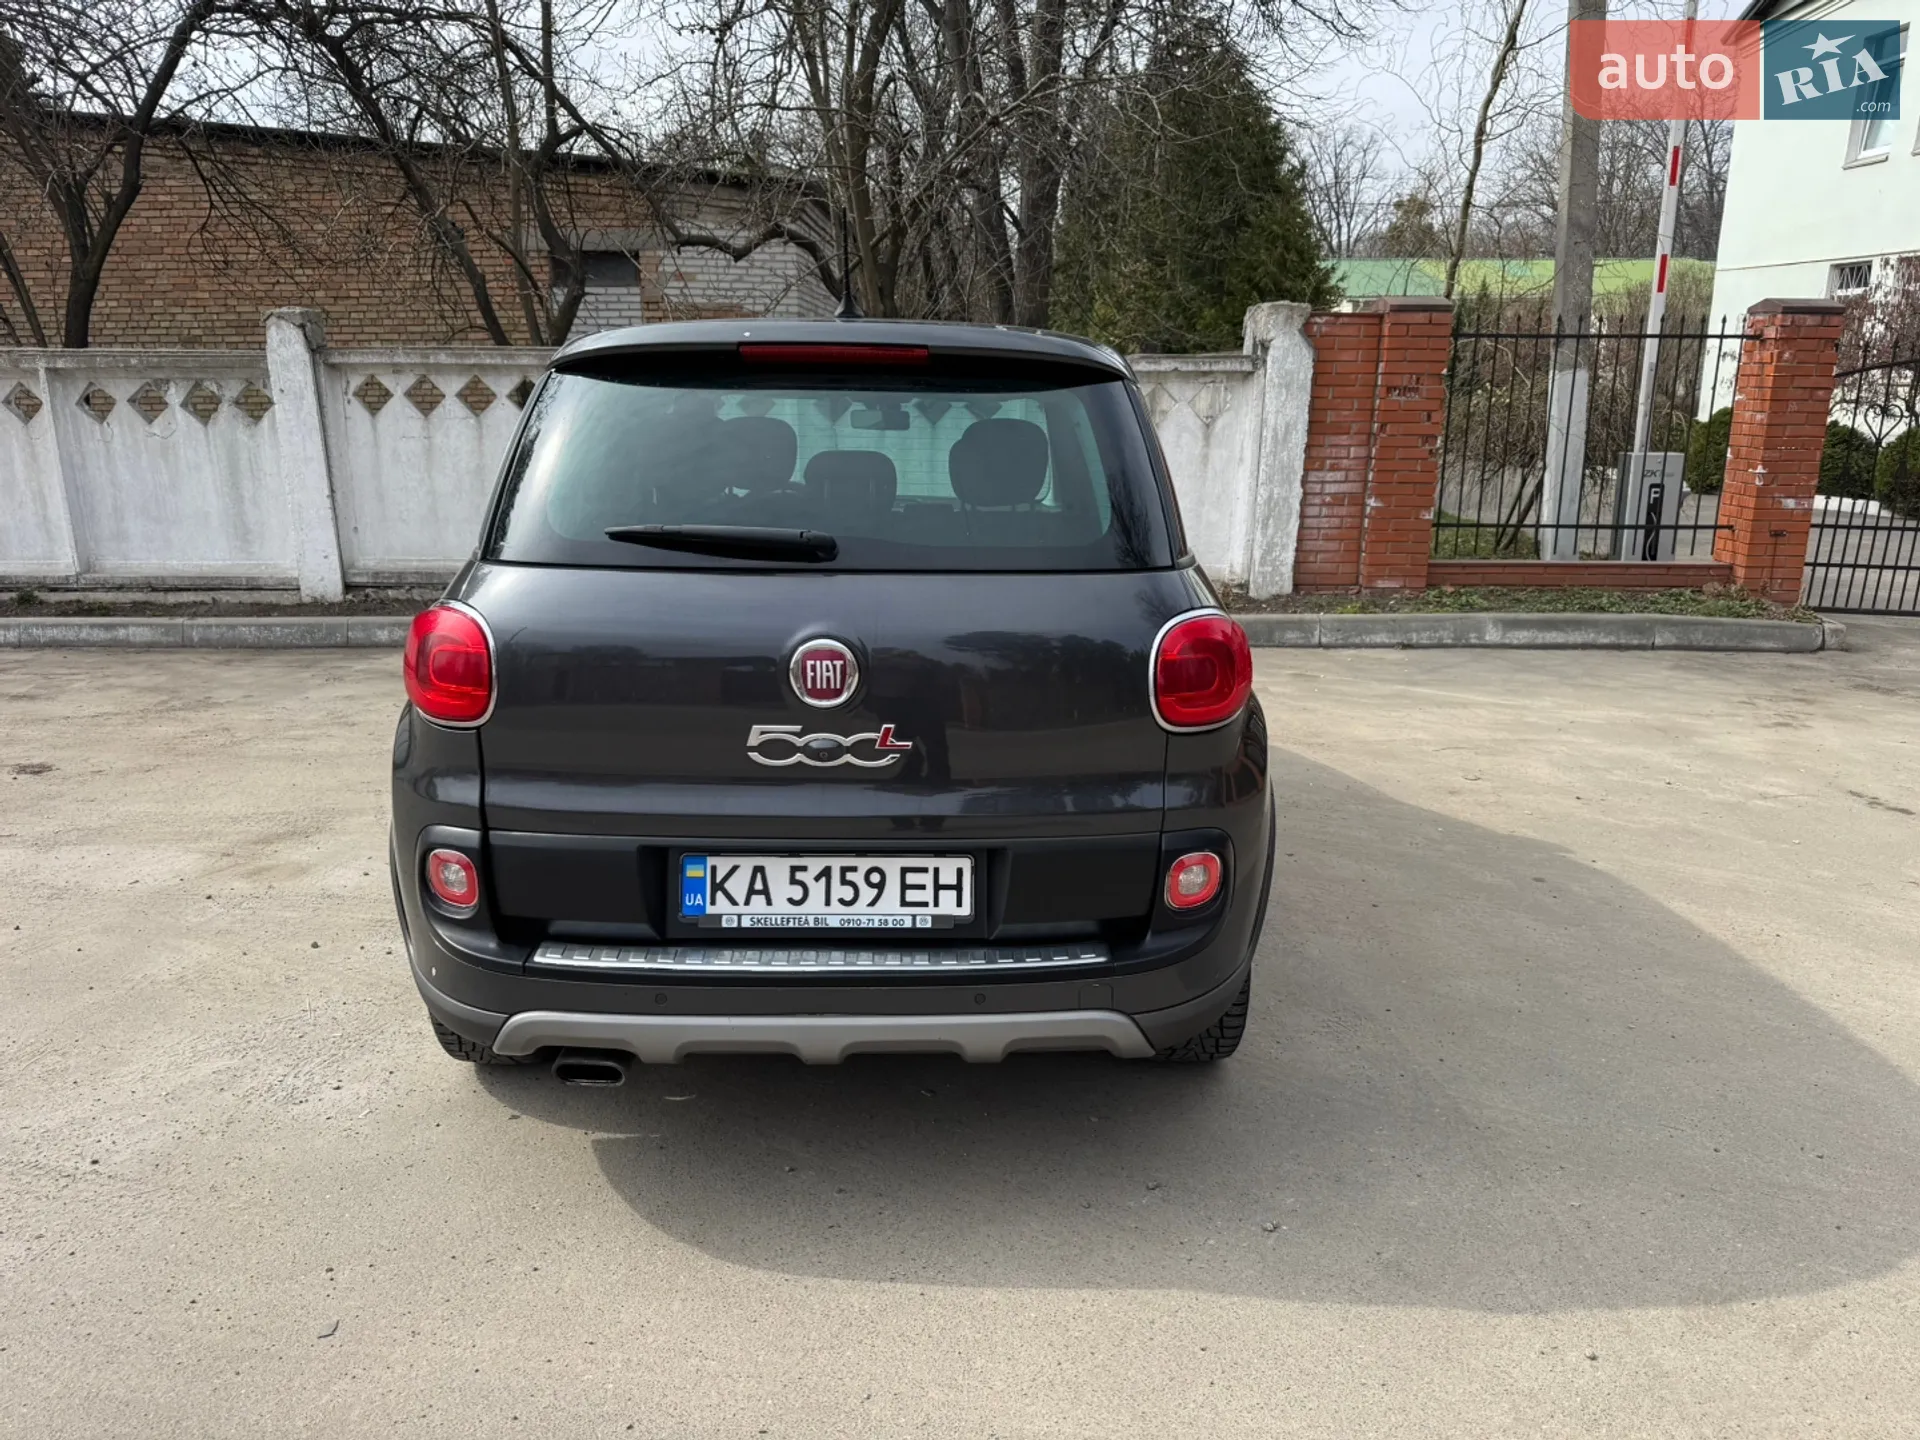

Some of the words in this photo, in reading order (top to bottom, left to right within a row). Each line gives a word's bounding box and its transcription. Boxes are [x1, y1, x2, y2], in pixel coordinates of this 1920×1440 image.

[806, 660, 844, 689] FIAT
[746, 724, 913, 768] 500L
[685, 893, 703, 906] UA
[709, 865, 773, 907] KA
[786, 865, 886, 907] 5159
[899, 866, 963, 908] EH
[813, 917, 830, 927] BIL
[839, 917, 875, 927] 0910-71
[877, 917, 889, 927] 58
[892, 917, 905, 927] 00
